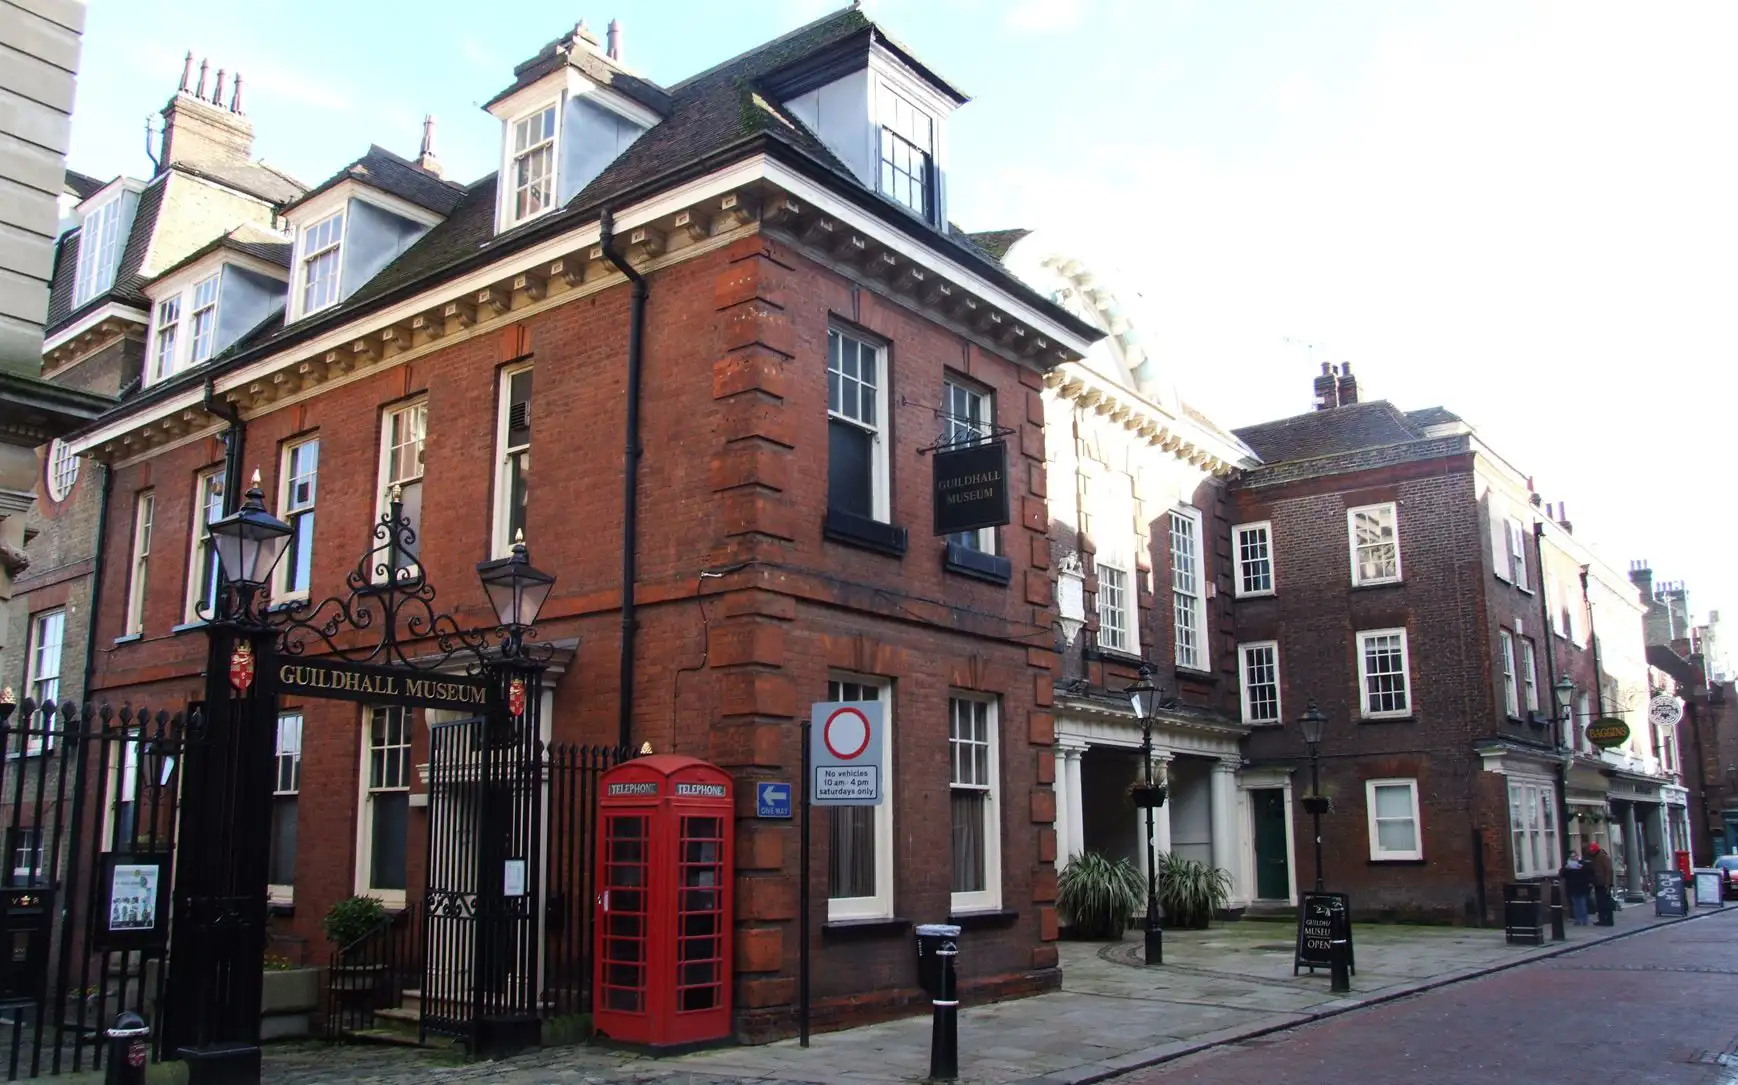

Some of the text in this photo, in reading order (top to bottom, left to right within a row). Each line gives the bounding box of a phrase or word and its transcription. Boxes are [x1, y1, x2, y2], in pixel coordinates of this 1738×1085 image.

[938, 470, 1001, 489] GUILDHALL
[947, 487, 993, 504] MUSEUM
[279, 664, 487, 704] GUILDHALL MUSEUM
[611, 783, 657, 795] TELEPHONE
[677, 784, 722, 796] TELEPHONE
[819, 787, 874, 796] saturdays only
[760, 807, 788, 815] ONE WAY
[1305, 927, 1331, 936] MUSEU
[1307, 939, 1331, 949] OPEN
